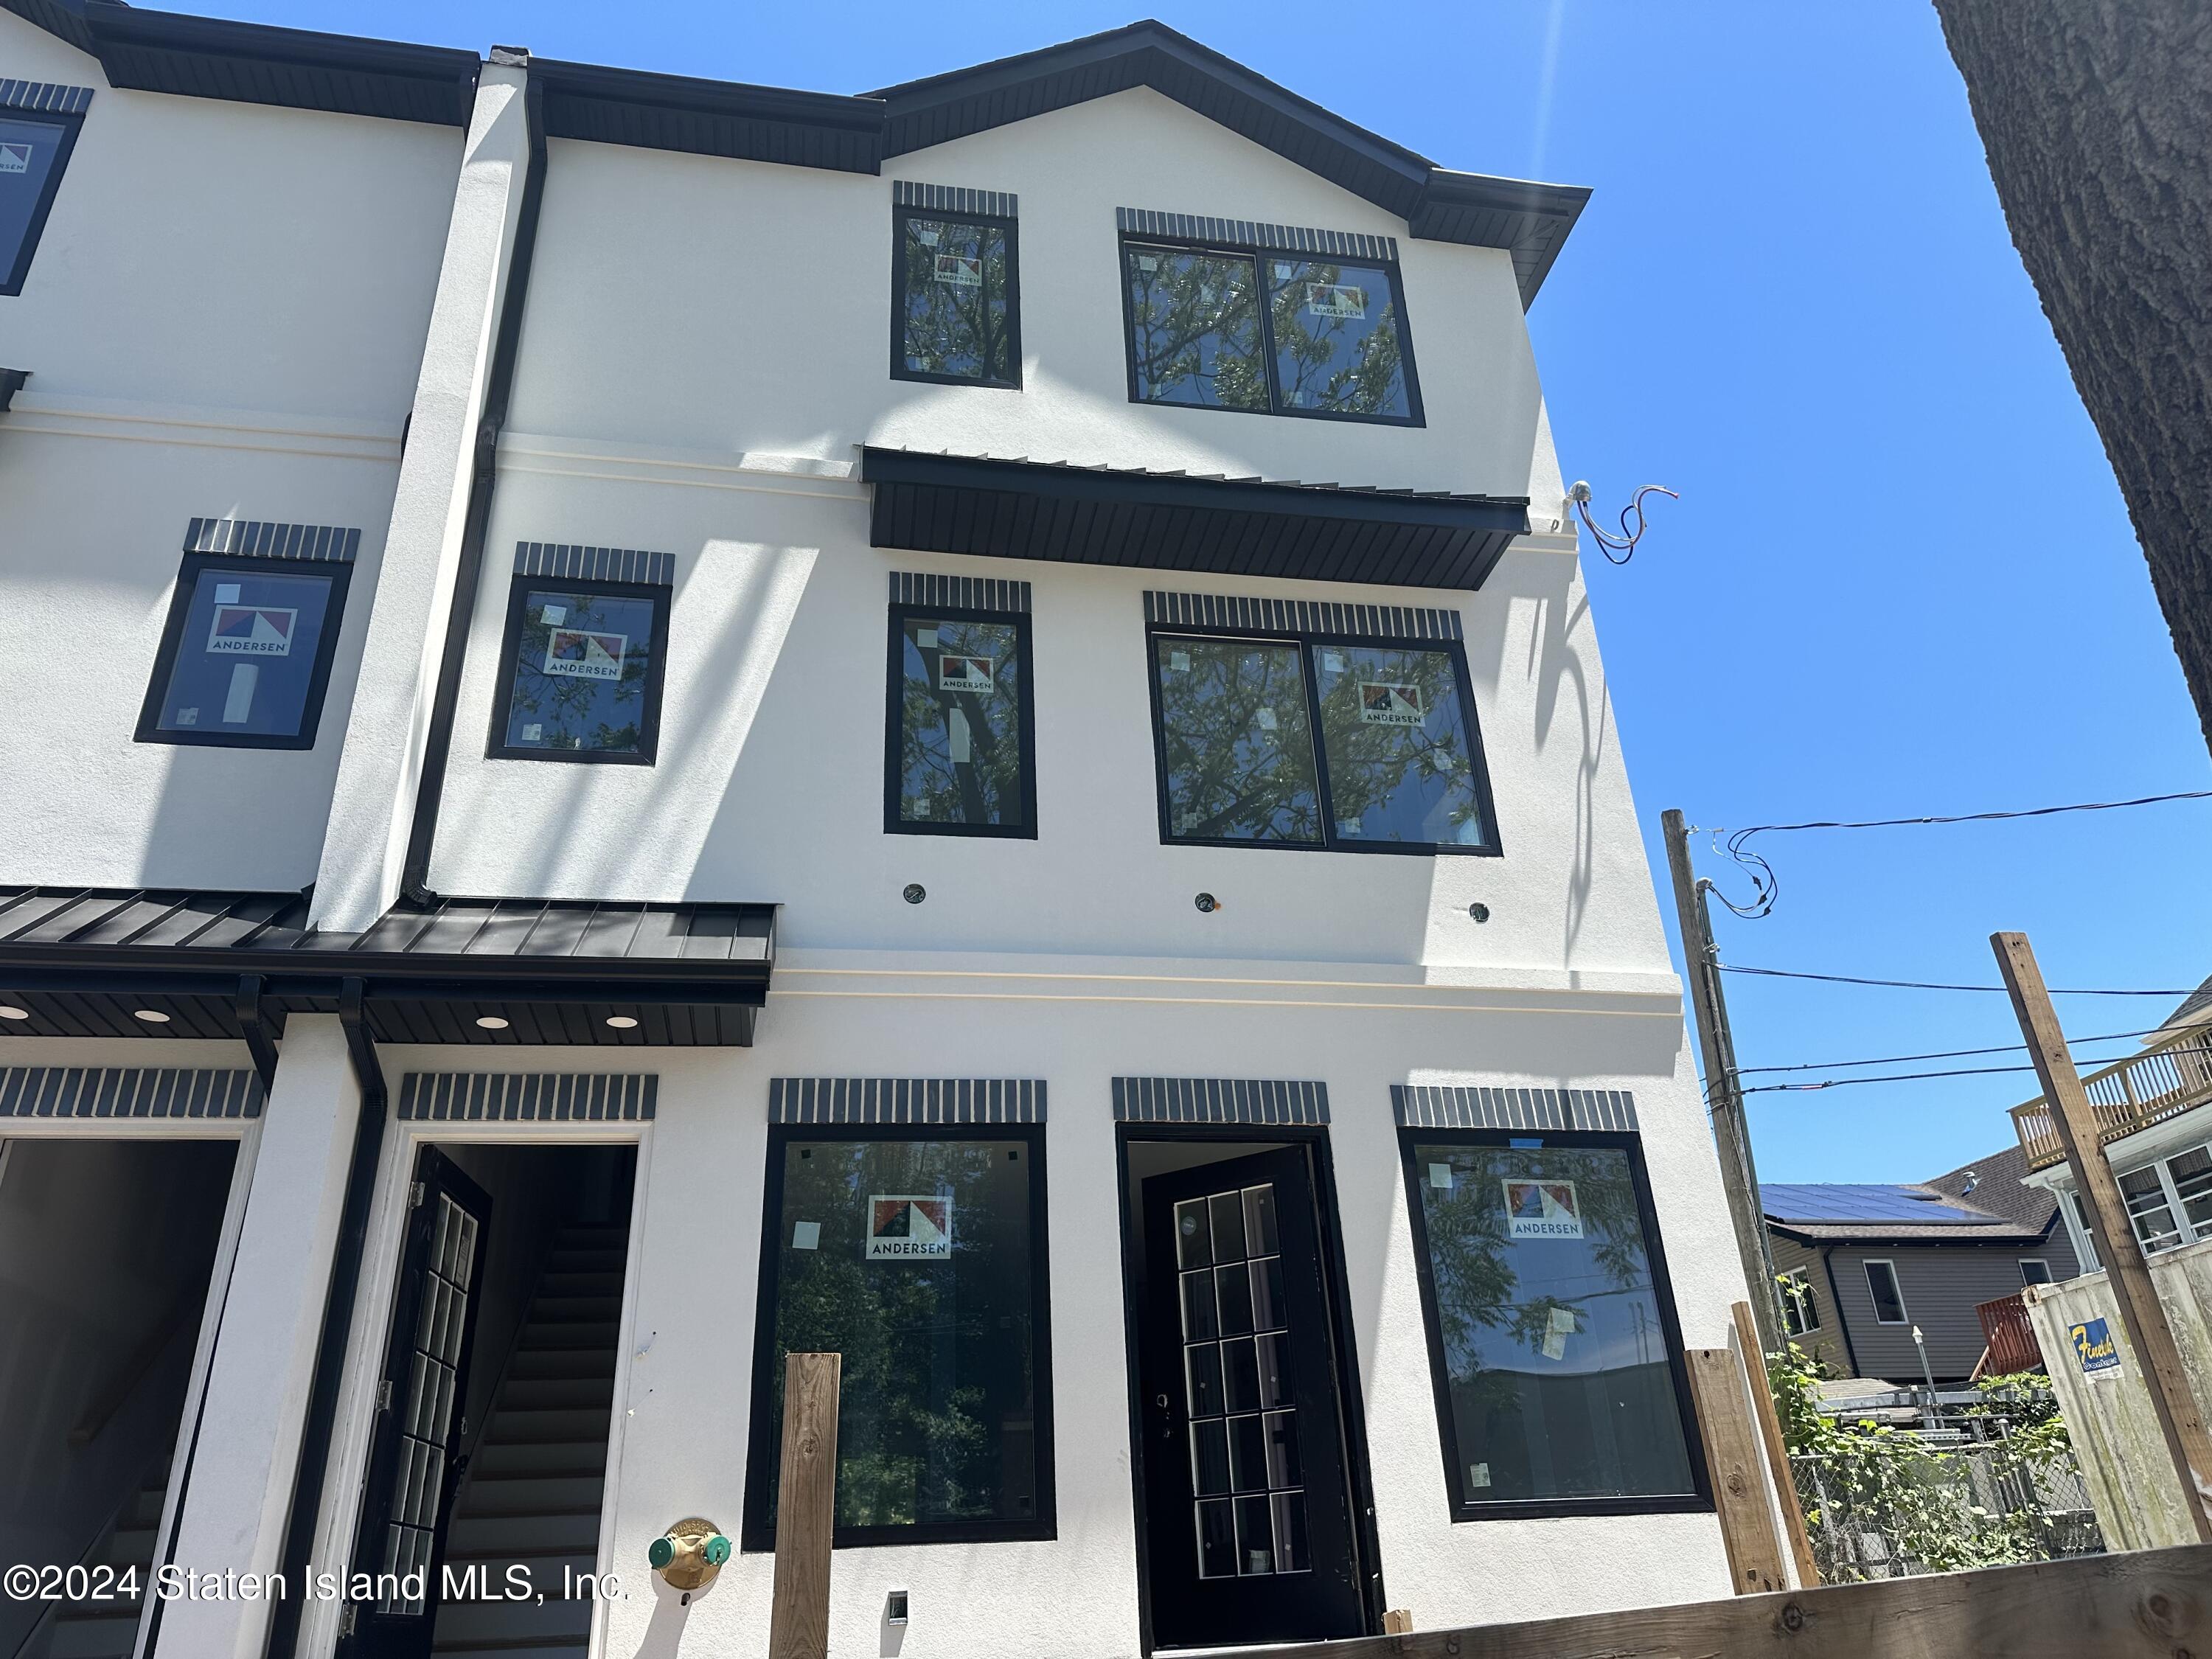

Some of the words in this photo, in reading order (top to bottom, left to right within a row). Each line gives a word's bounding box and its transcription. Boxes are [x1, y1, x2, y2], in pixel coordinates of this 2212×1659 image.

[937, 274, 979, 283] ANDERSEN
[1313, 307, 1362, 317] ANDERSEN
[212, 641, 287, 652] ANDERSEN
[549, 663, 618, 676] ANDERSEN
[943, 681, 991, 689] ANDERSEN
[1366, 714, 1422, 723] ANDERSEN
[1515, 1223, 1579, 1234] ANDERSEN
[872, 1243, 946, 1254] ANDERSEN
